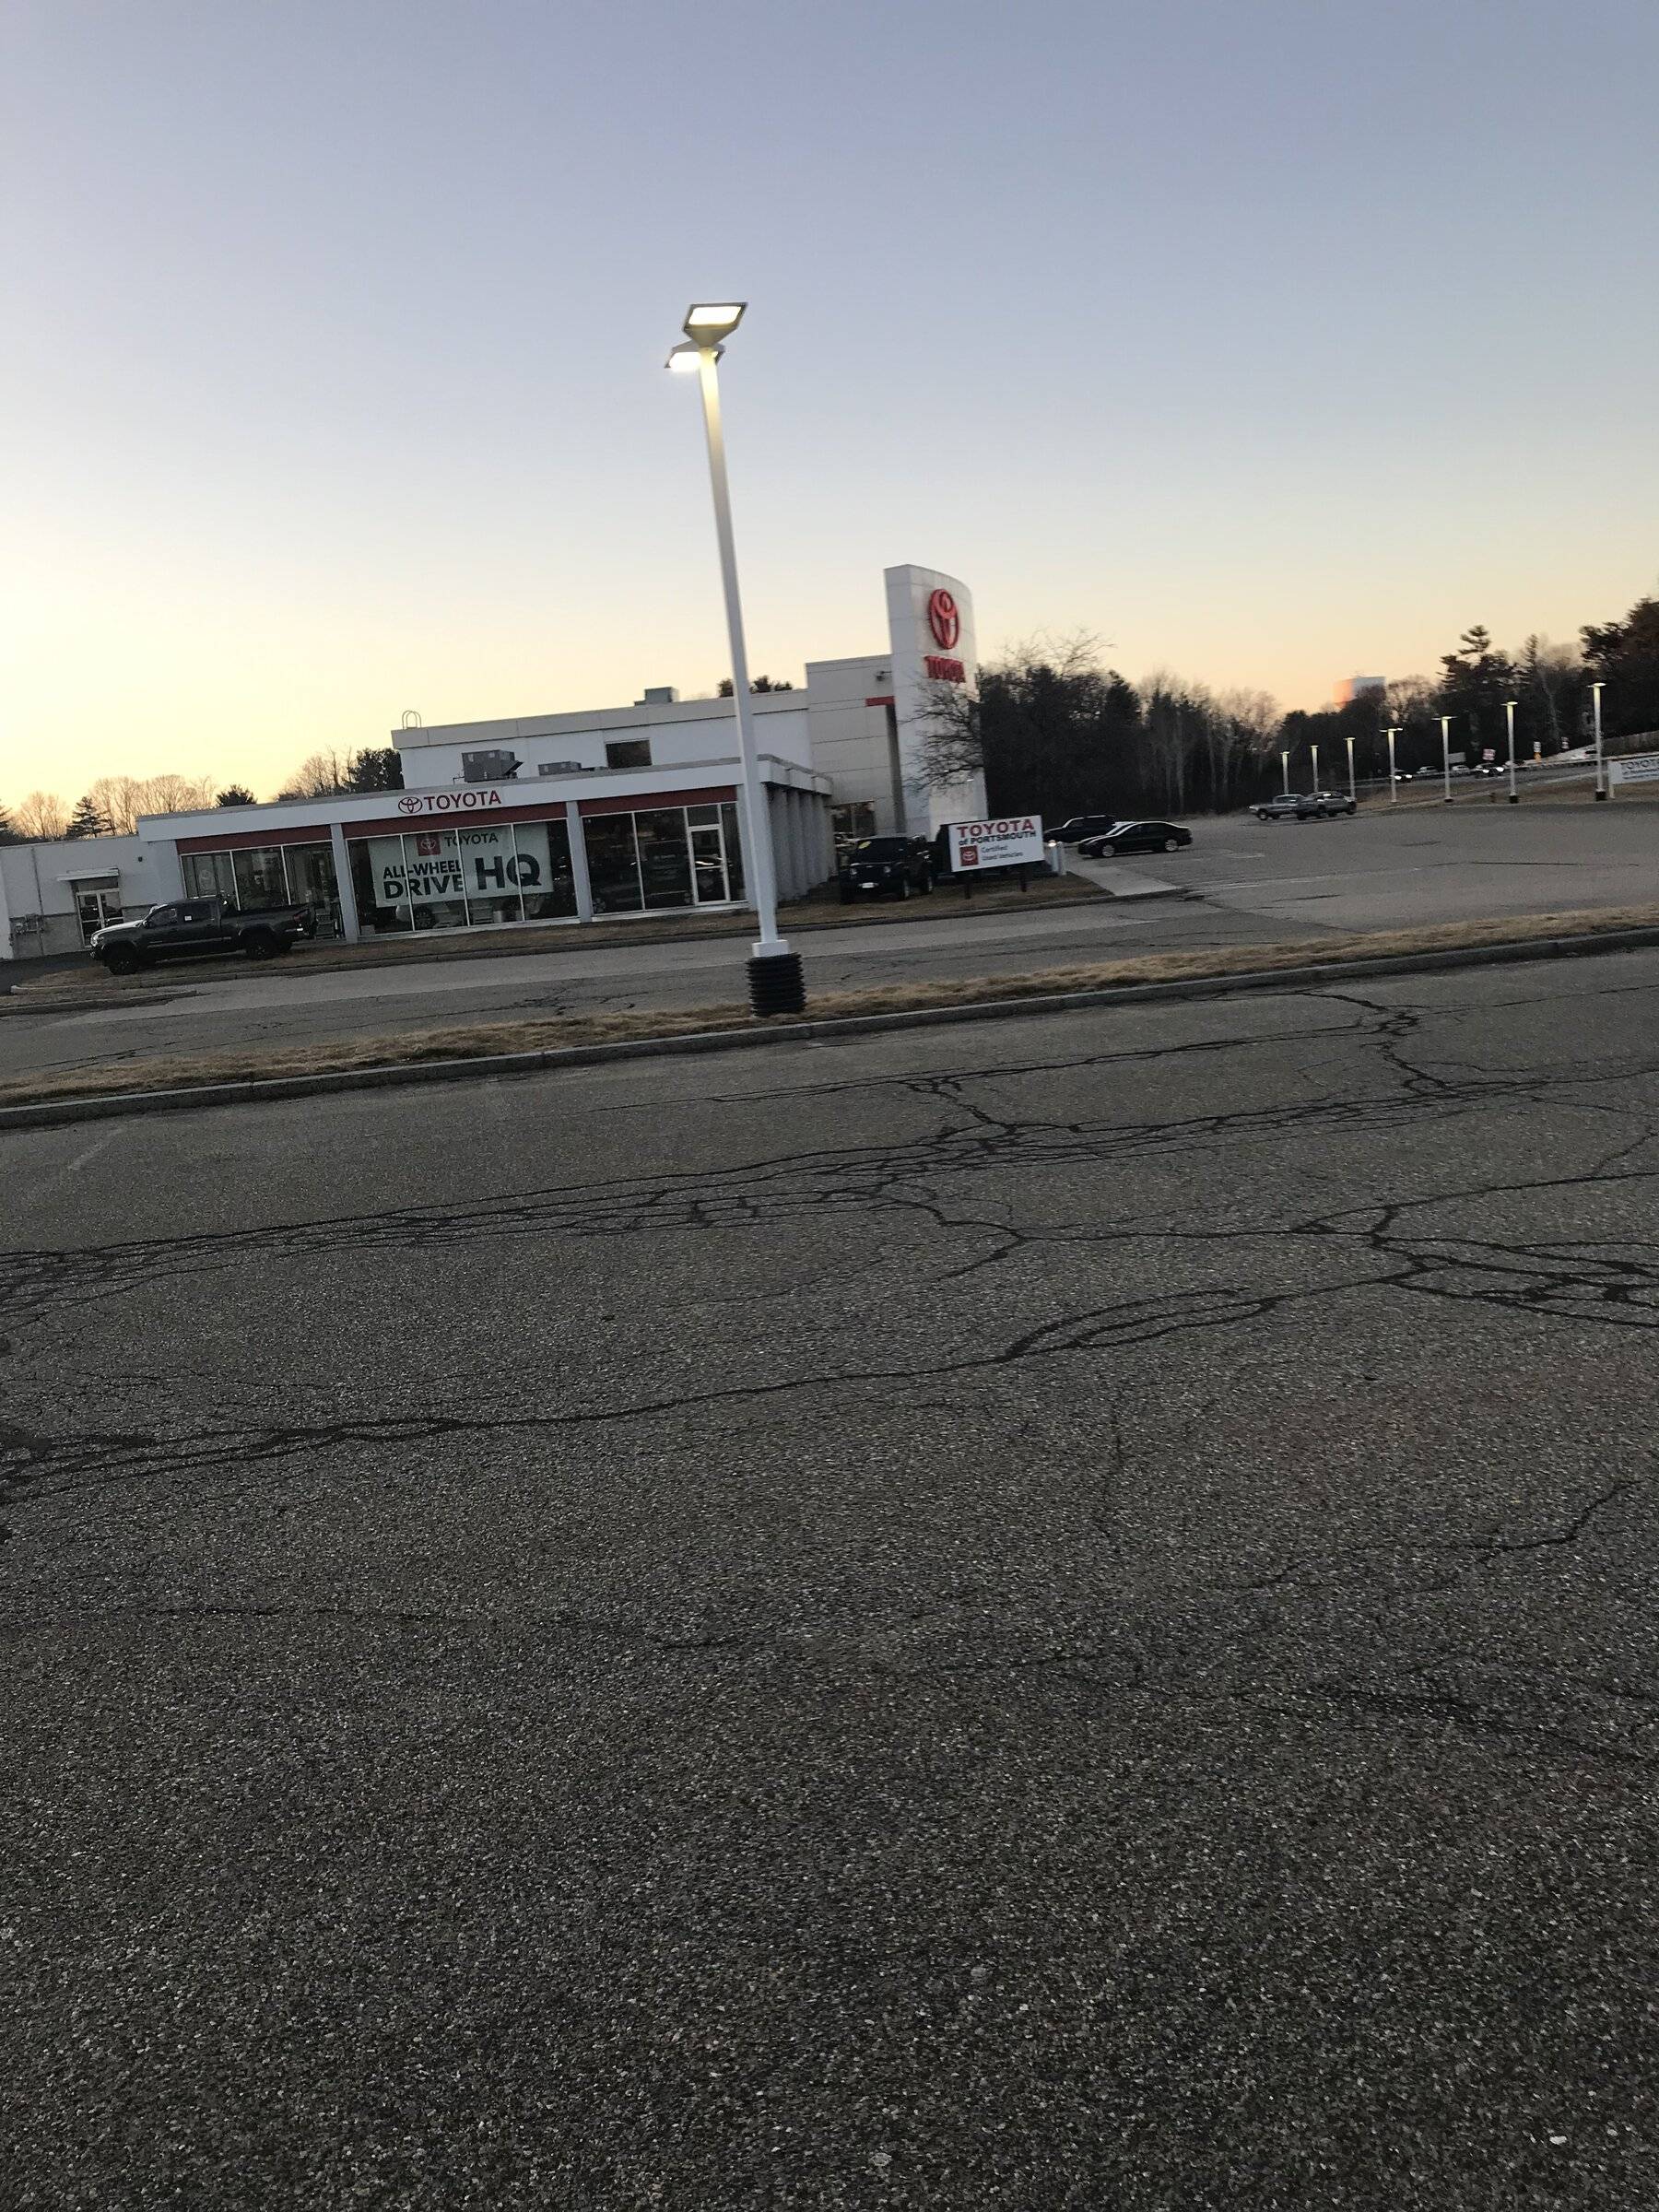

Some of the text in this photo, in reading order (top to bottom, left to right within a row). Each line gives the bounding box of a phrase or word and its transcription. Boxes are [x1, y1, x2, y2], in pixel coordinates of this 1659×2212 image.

[424, 790, 501, 811] TOYOTA
[957, 818, 1034, 838] TOYOTA
[444, 832, 499, 848] TOYOTA
[959, 831, 1036, 846] of PORTSMOUTH
[383, 860, 463, 878] ALL-WHEEL
[475, 853, 542, 890] HQ
[383, 875, 464, 899] DRIVE
